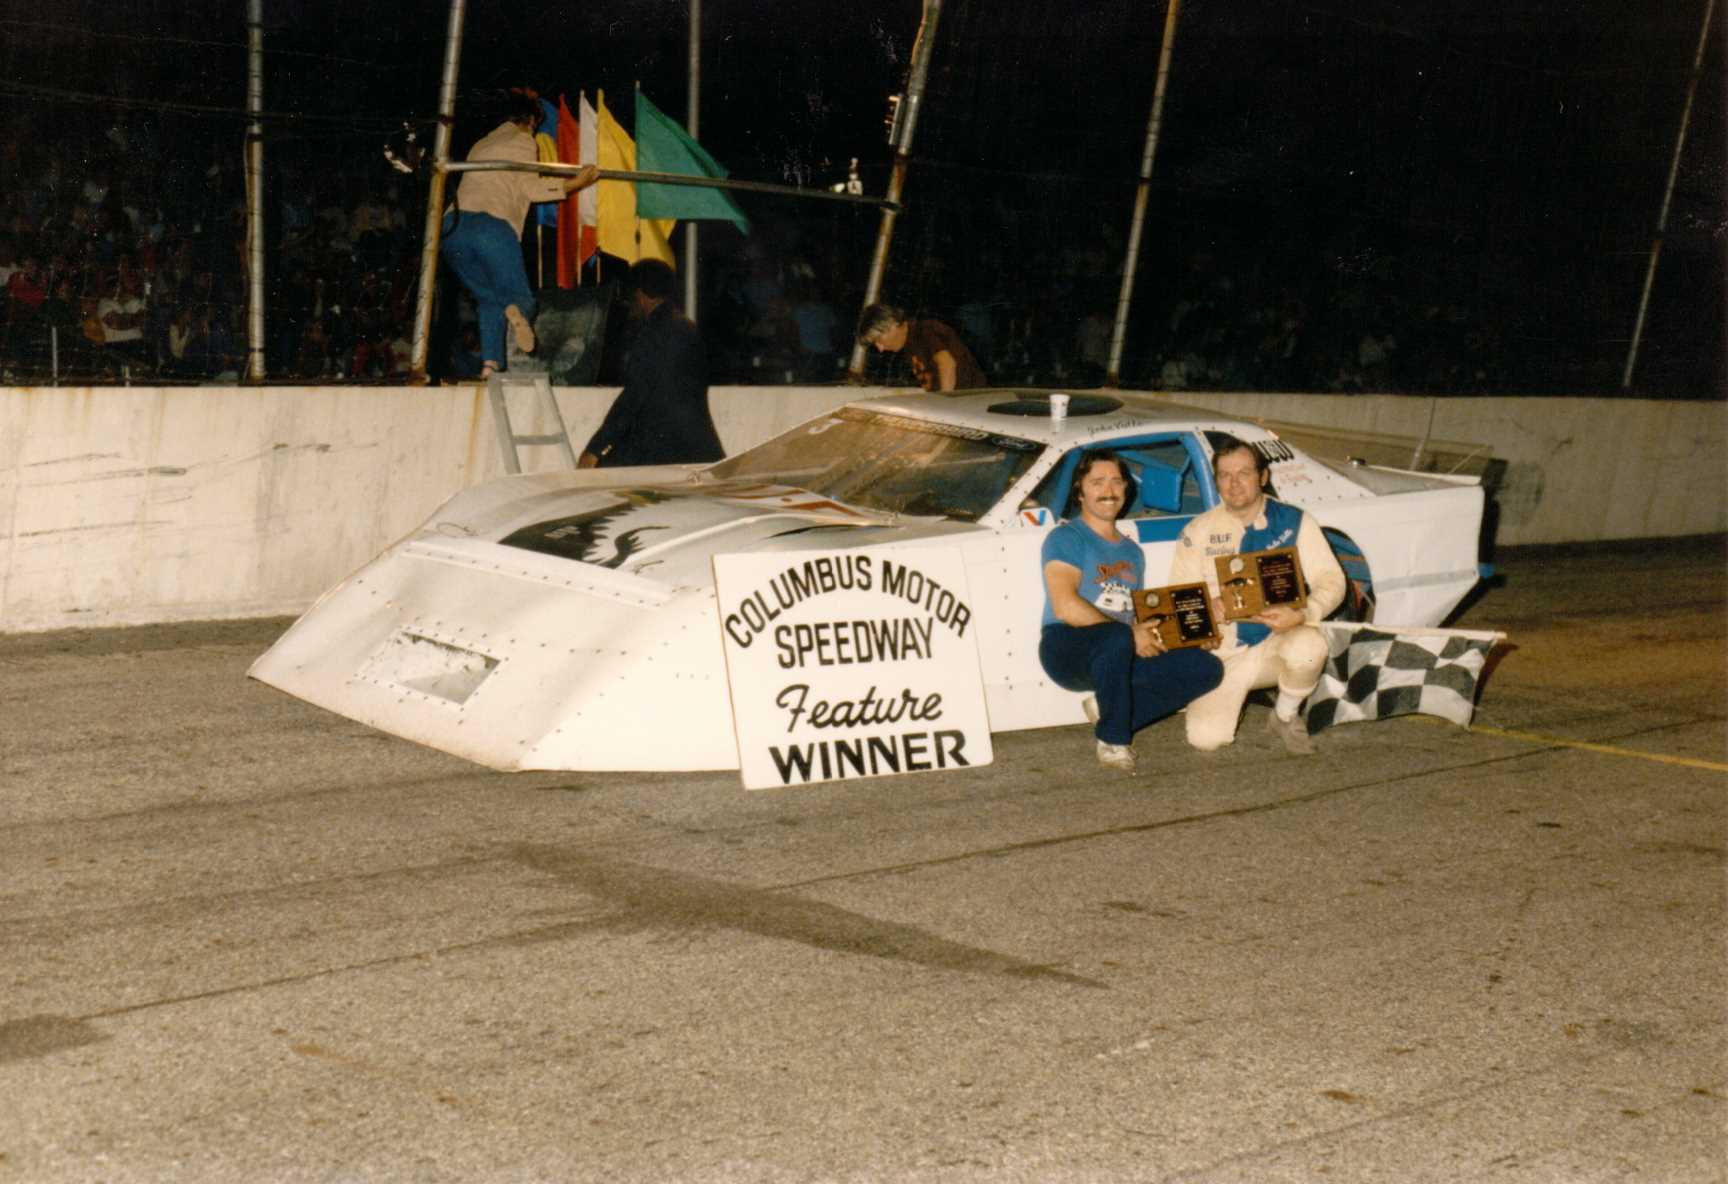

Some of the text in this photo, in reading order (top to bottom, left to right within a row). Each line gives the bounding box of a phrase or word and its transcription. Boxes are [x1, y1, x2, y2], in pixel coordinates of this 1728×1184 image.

[724, 554, 972, 649] COLUMBUS MOTOR
[774, 617, 934, 669] SPEEDWAY
[775, 683, 943, 734] Feature
[768, 729, 970, 785] WINNER
